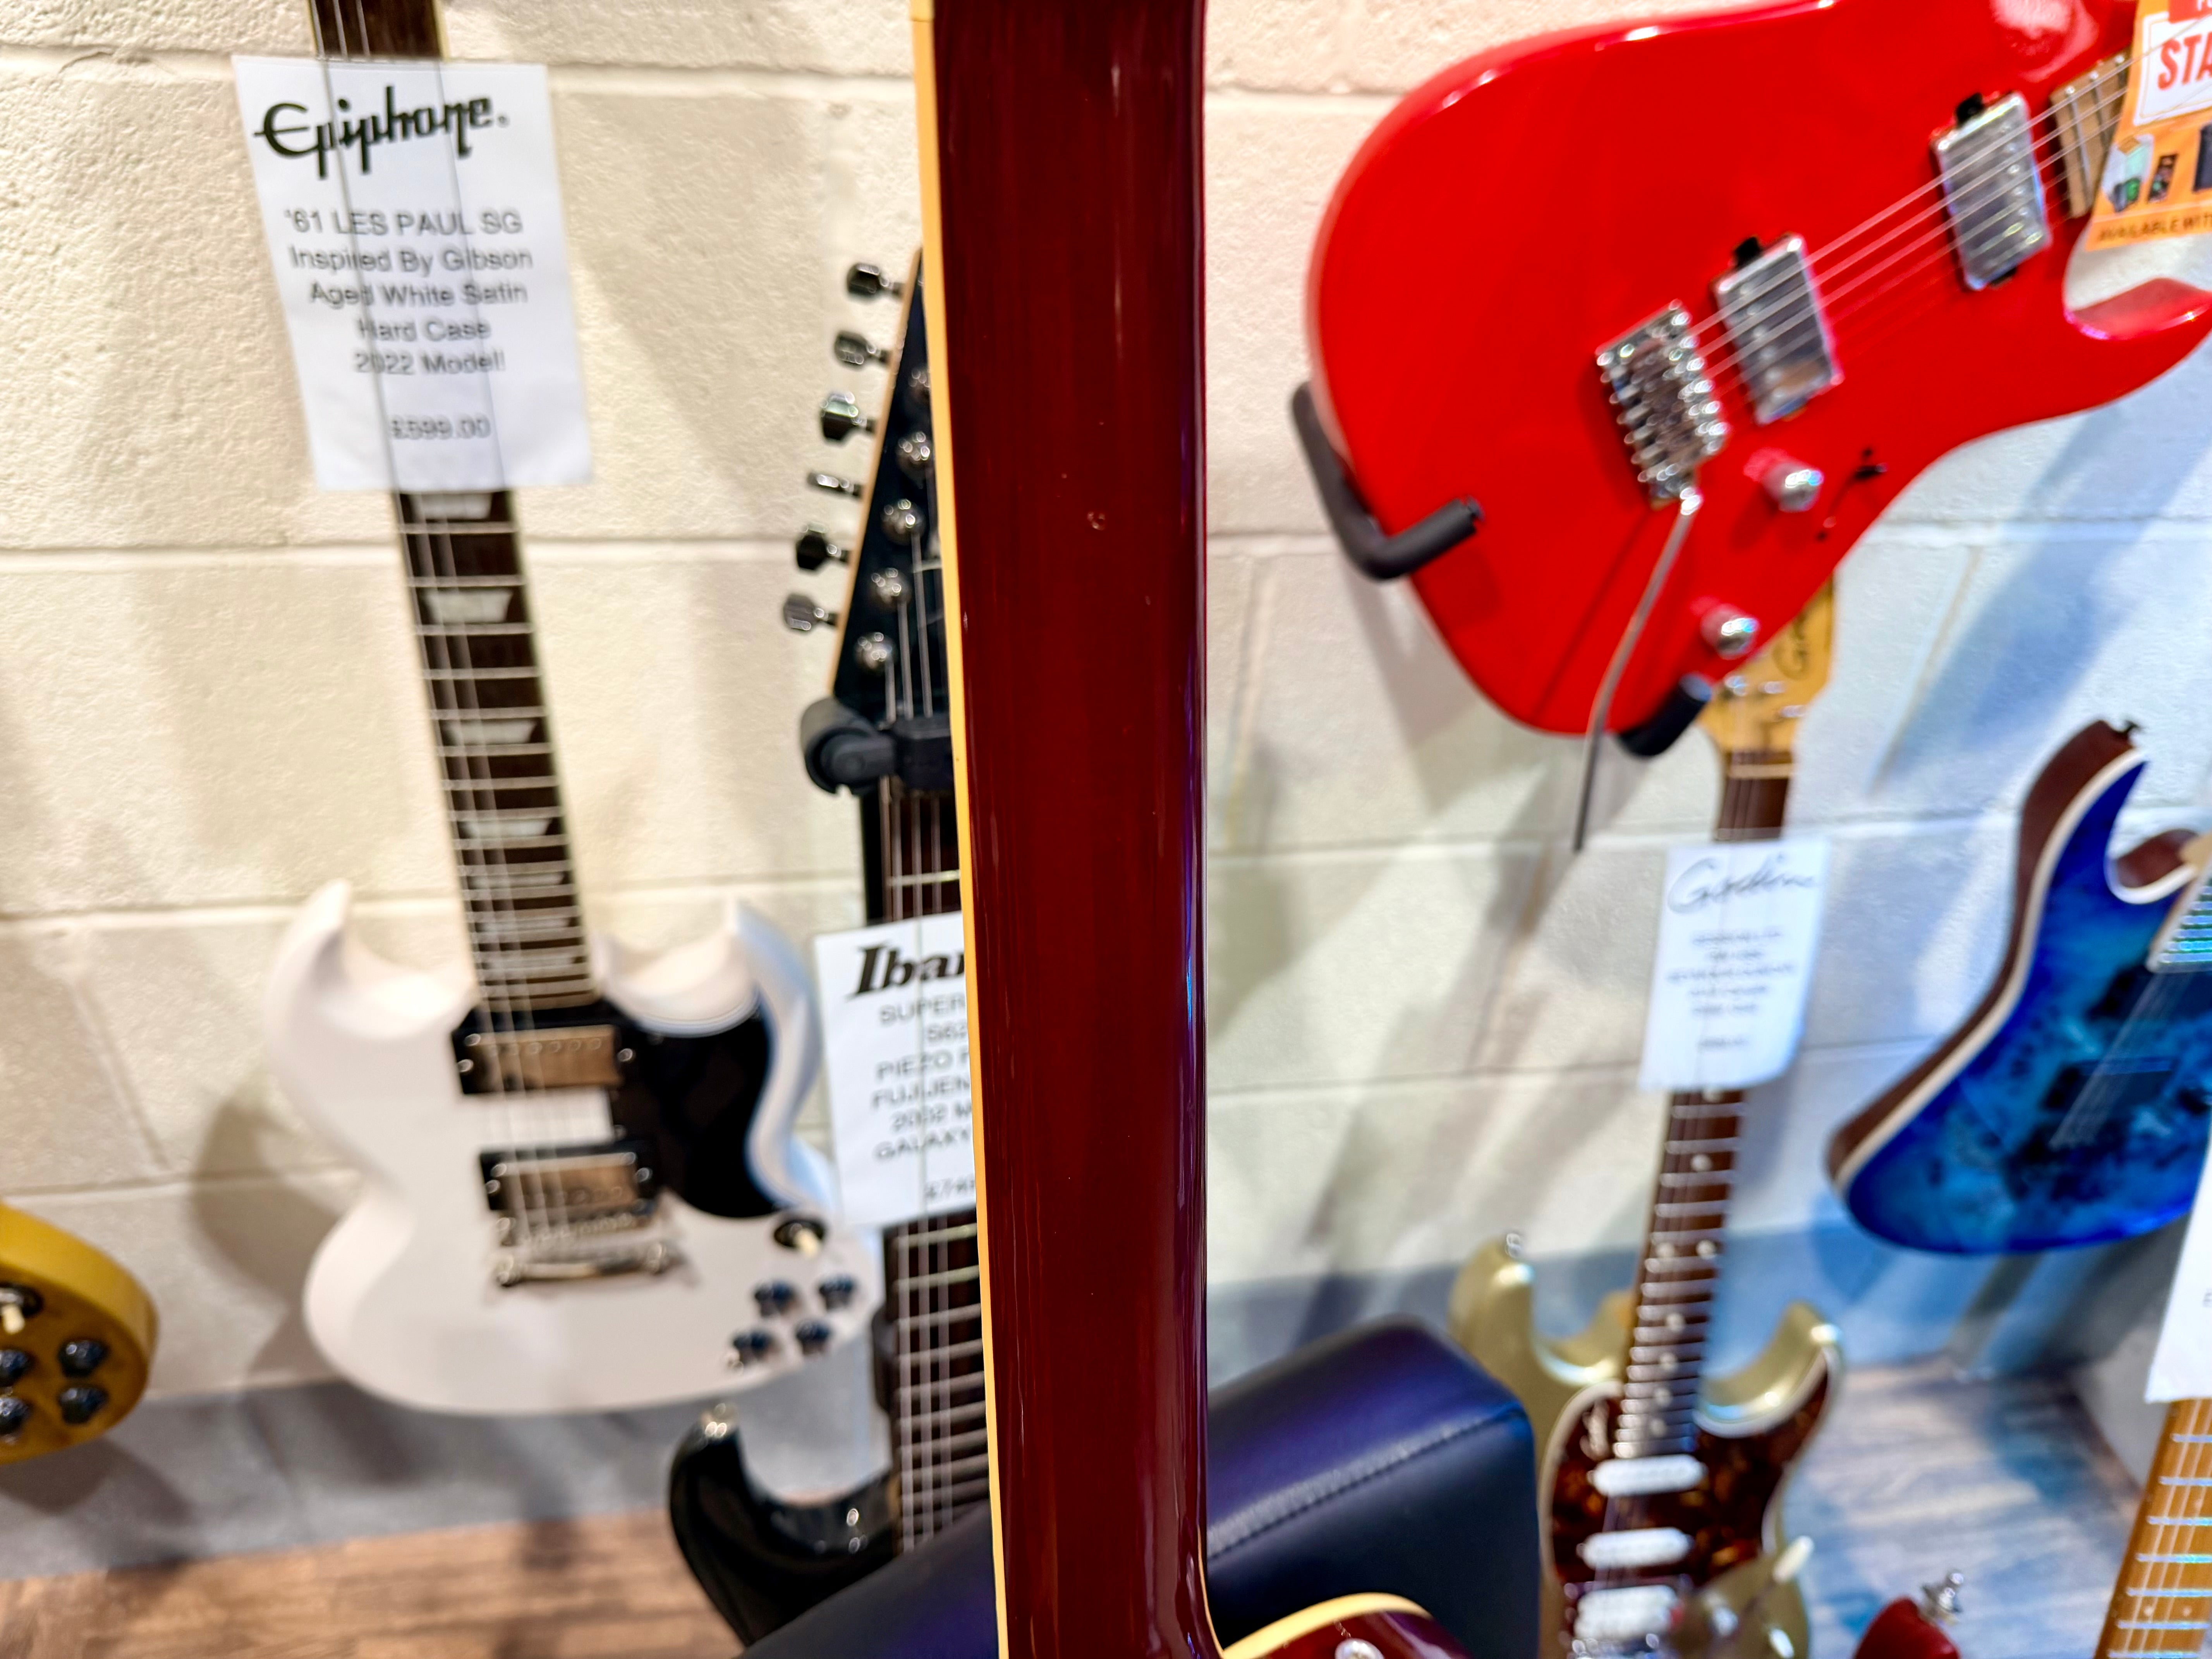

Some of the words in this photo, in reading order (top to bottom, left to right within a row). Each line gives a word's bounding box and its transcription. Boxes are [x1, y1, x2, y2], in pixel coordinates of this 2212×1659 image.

[253, 85, 493, 180] Epiphone
[331, 211, 388, 235] LES
[397, 212, 473, 235] PAUL
[480, 211, 523, 233] SG
[289, 246, 392, 272] Inspired
[400, 250, 433, 278] By
[440, 246, 533, 270] Gibson
[310, 282, 374, 310] Aged
[380, 283, 455, 306] White
[463, 282, 528, 305] Satin
[356, 318, 417, 342] Hard
[422, 317, 491, 342] Case
[354, 350, 415, 375] 2022
